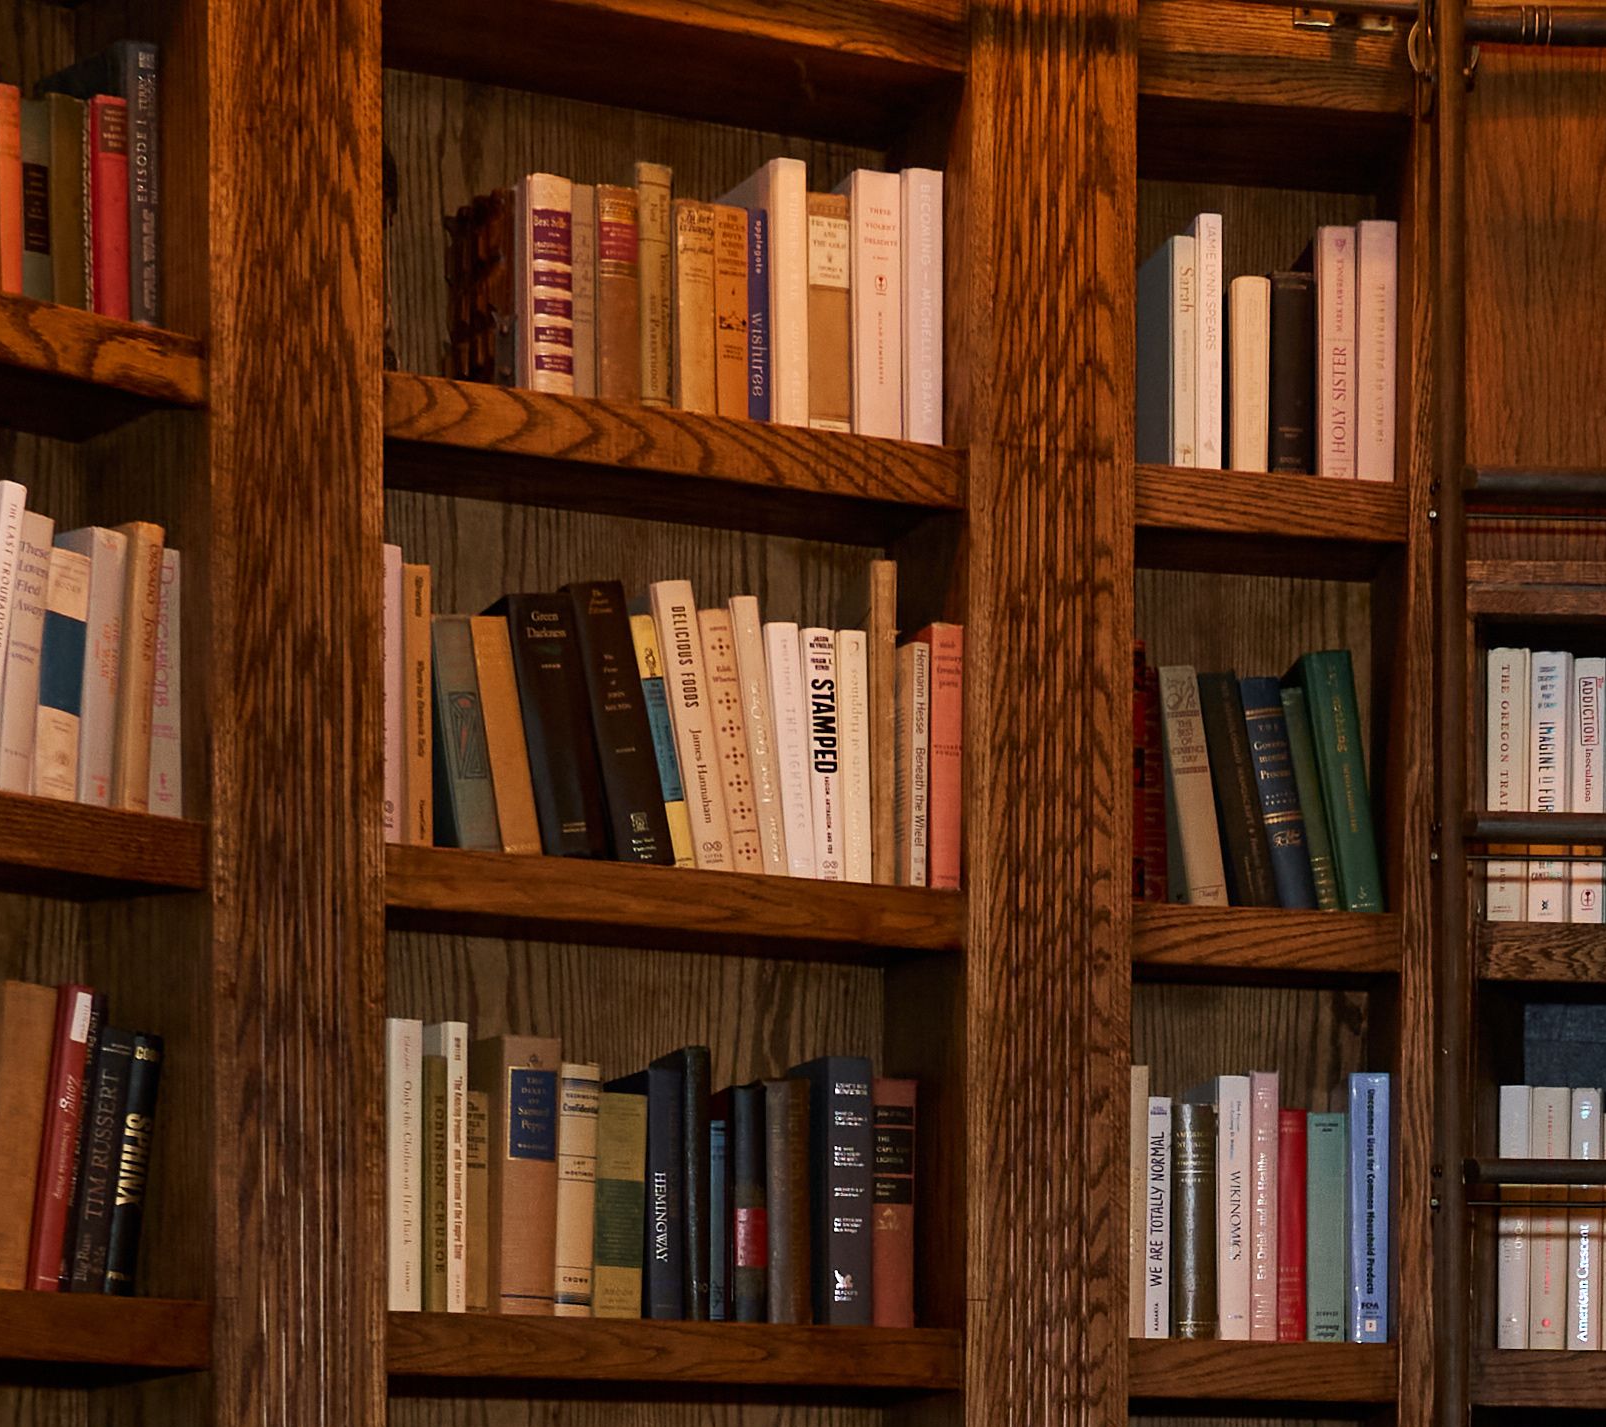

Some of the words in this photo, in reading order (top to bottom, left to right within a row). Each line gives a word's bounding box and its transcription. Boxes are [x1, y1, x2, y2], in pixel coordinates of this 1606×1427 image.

[865, 222, 896, 231] VIOLENT
[869, 207, 891, 216] THESE
[864, 237, 898, 247] DELIGHTS
[1206, 223, 1218, 260] JAMIE
[1179, 266, 1194, 313] Sarah
[1206, 263, 1218, 295] LYNN
[1206, 298, 1218, 351] SPEARS
[752, 313, 764, 397] wishtree
[1333, 346, 1347, 401] SISTER
[1331, 408, 1347, 454] HOLY
[7, 502, 17, 521] THE
[0, 525, 14, 557] LAST
[21, 540, 50, 560] These
[16, 579, 41, 597] Fled
[527, 626, 566, 639] Darkness
[531, 610, 559, 623] Green
[671, 606, 693, 669] DELICIOUS
[681, 673, 699, 709] FOODS
[916, 648, 926, 699] Hermann
[811, 678, 838, 774] STAMPED
[916, 702, 926, 735] Hesse
[1581, 679, 1594, 743] ADDICTION
[1538, 721, 1556, 769] IMAGINE
[689, 729, 704, 762] James
[697, 765, 712, 824] Hannaham
[914, 747, 926, 793] Beneath
[1584, 748, 1592, 803] Inoculation
[914, 795, 925, 811] the
[914, 814, 925, 848] Wheel
[91, 1071, 120, 1178] RUSSERT
[562, 1102, 599, 1114] Confidential
[114, 1113, 151, 1206] SPHINX
[1150, 1131, 1165, 1187] NORMAL
[85, 1182, 104, 1219] TIM
[654, 1172, 668, 1262] HEMINGWAY
[1150, 1189, 1164, 1236] TOTALLY
[1229, 1170, 1242, 1261] WIKINOMICS
[1149, 1240, 1163, 1262] ARE
[1578, 1224, 1589, 1279] Crescent
[1149, 1266, 1162, 1287] WE
[1577, 1280, 1589, 1343] American
